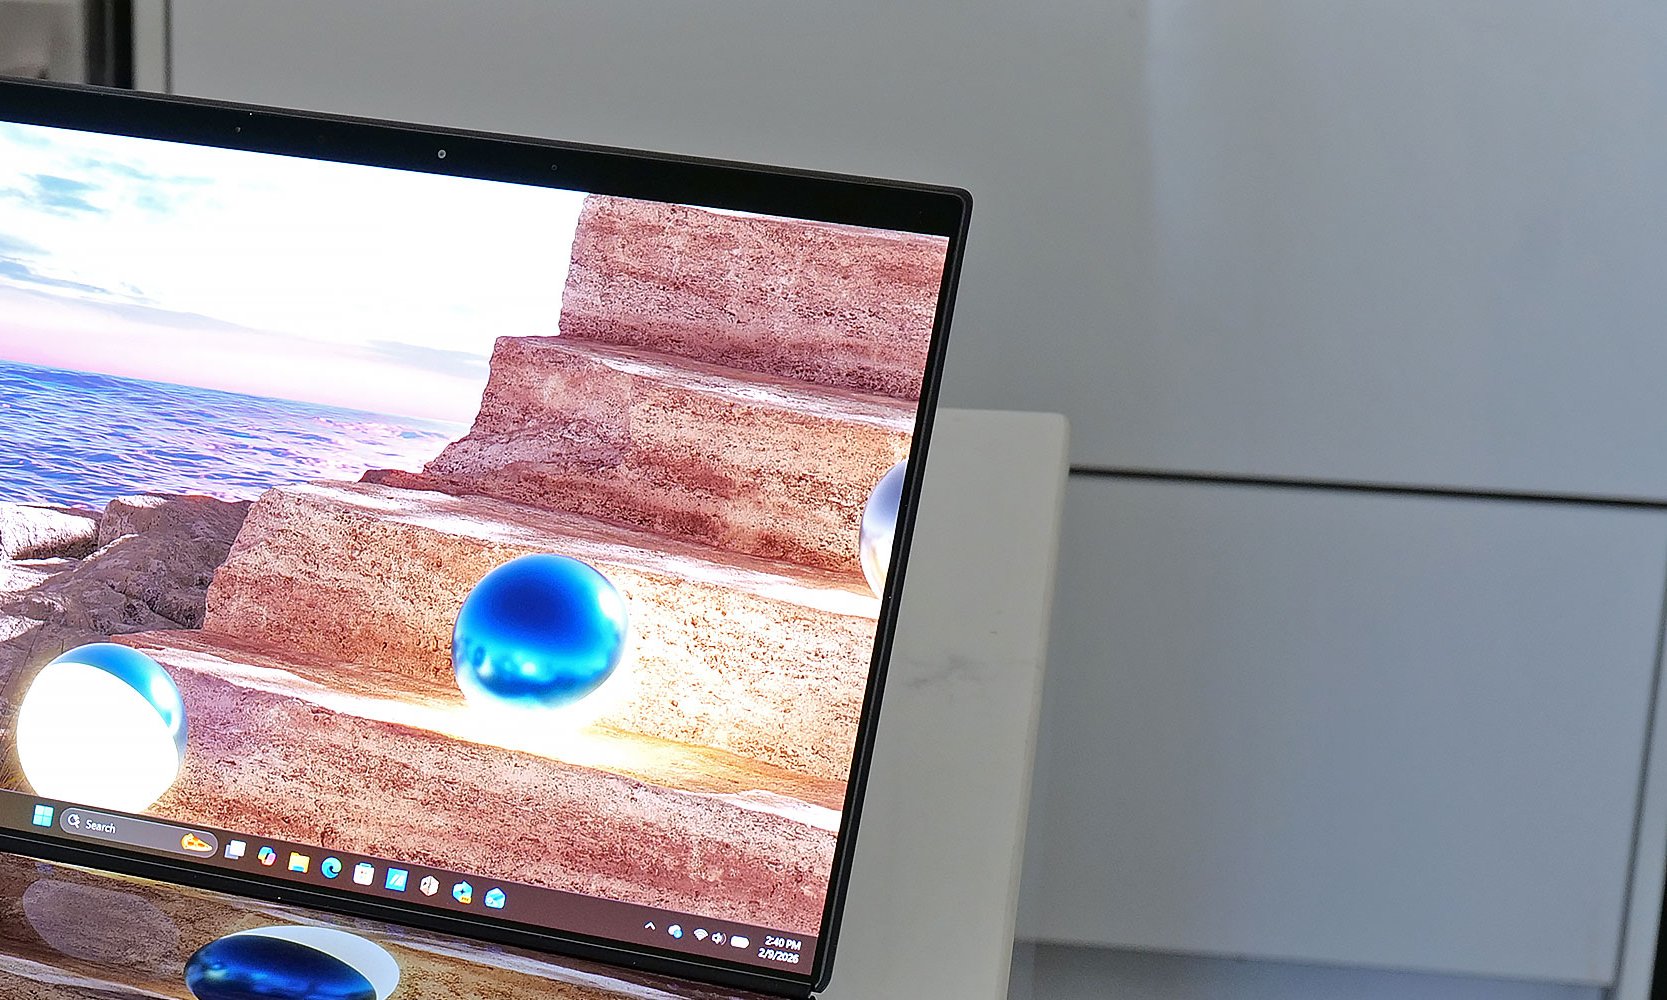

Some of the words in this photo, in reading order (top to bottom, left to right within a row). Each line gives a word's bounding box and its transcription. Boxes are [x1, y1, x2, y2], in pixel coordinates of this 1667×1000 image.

[85, 819, 116, 834] Search
[764, 934, 785, 948] 2:40
[785, 938, 802, 951] PM
[757, 947, 800, 964] 2/9/2026
